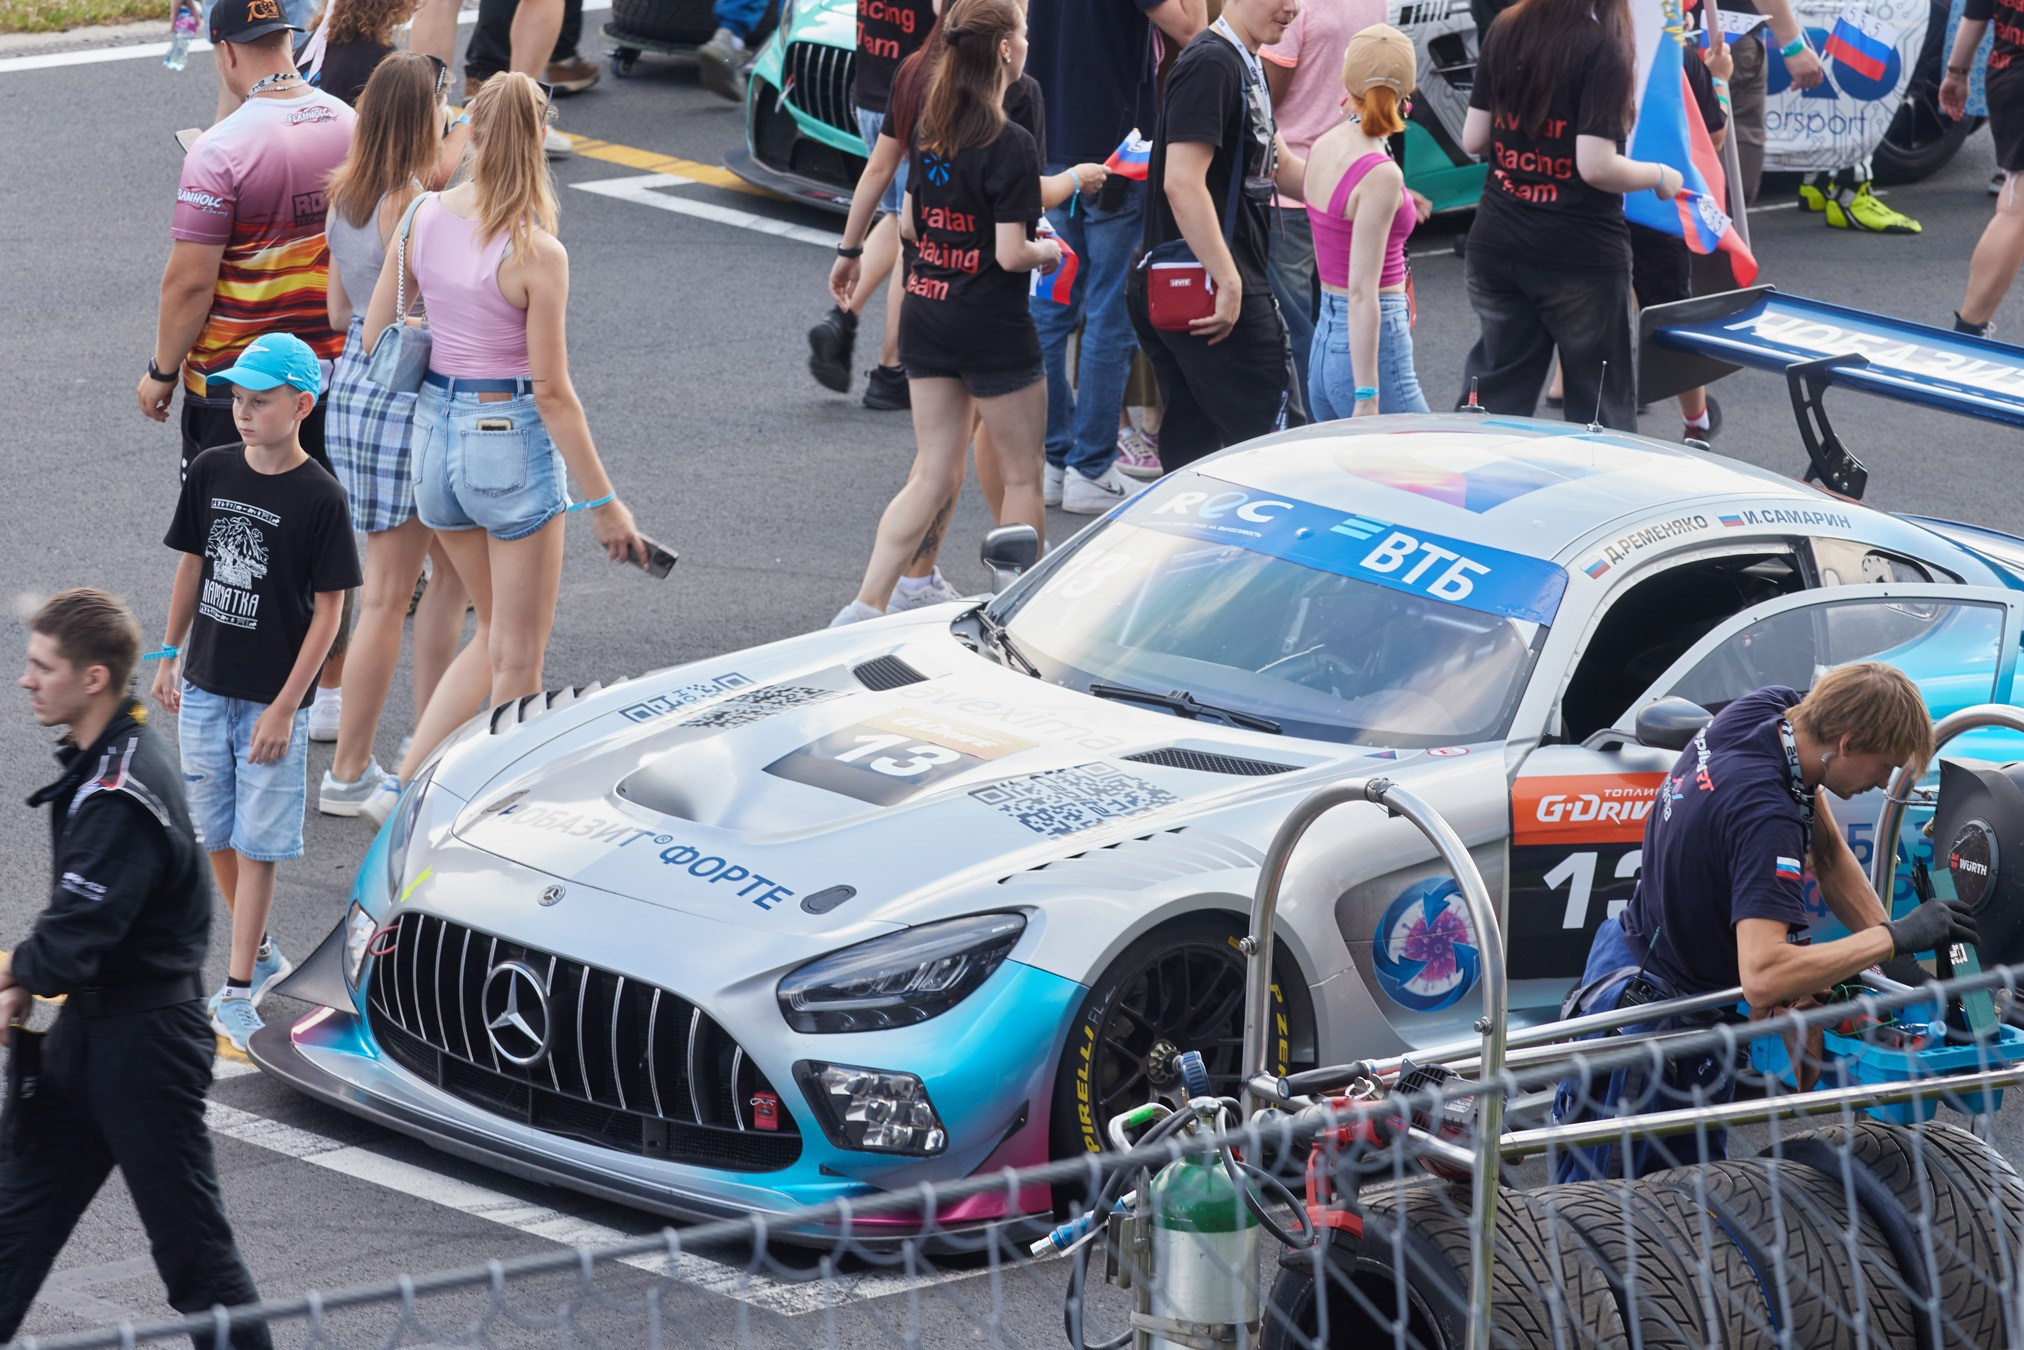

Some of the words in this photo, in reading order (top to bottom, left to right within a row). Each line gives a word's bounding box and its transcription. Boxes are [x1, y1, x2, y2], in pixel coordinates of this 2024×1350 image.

[857, 0, 915, 33] acing
[1494, 112, 1567, 138] Avar
[1764, 110, 1867, 139] orsport
[1494, 141, 1572, 179] Racing
[921, 206, 975, 232] vatar
[1723, 309, 2024, 399] НОБАЗИ
[1743, 510, 1852, 529] И.САМАРИН
[1603, 515, 1709, 565] Д.РЕМЕНЯКО
[1359, 531, 1492, 601] ВТБ
[834, 734, 962, 777] 13
[1604, 788, 1661, 797] ТОПЛИ
[1536, 794, 1654, 825] G-DRIV
[659, 844, 795, 911] ФОРТЕ
[1959, 858, 1988, 876] WÜRTH
[1076, 1025, 1100, 1153] PIRELLI
